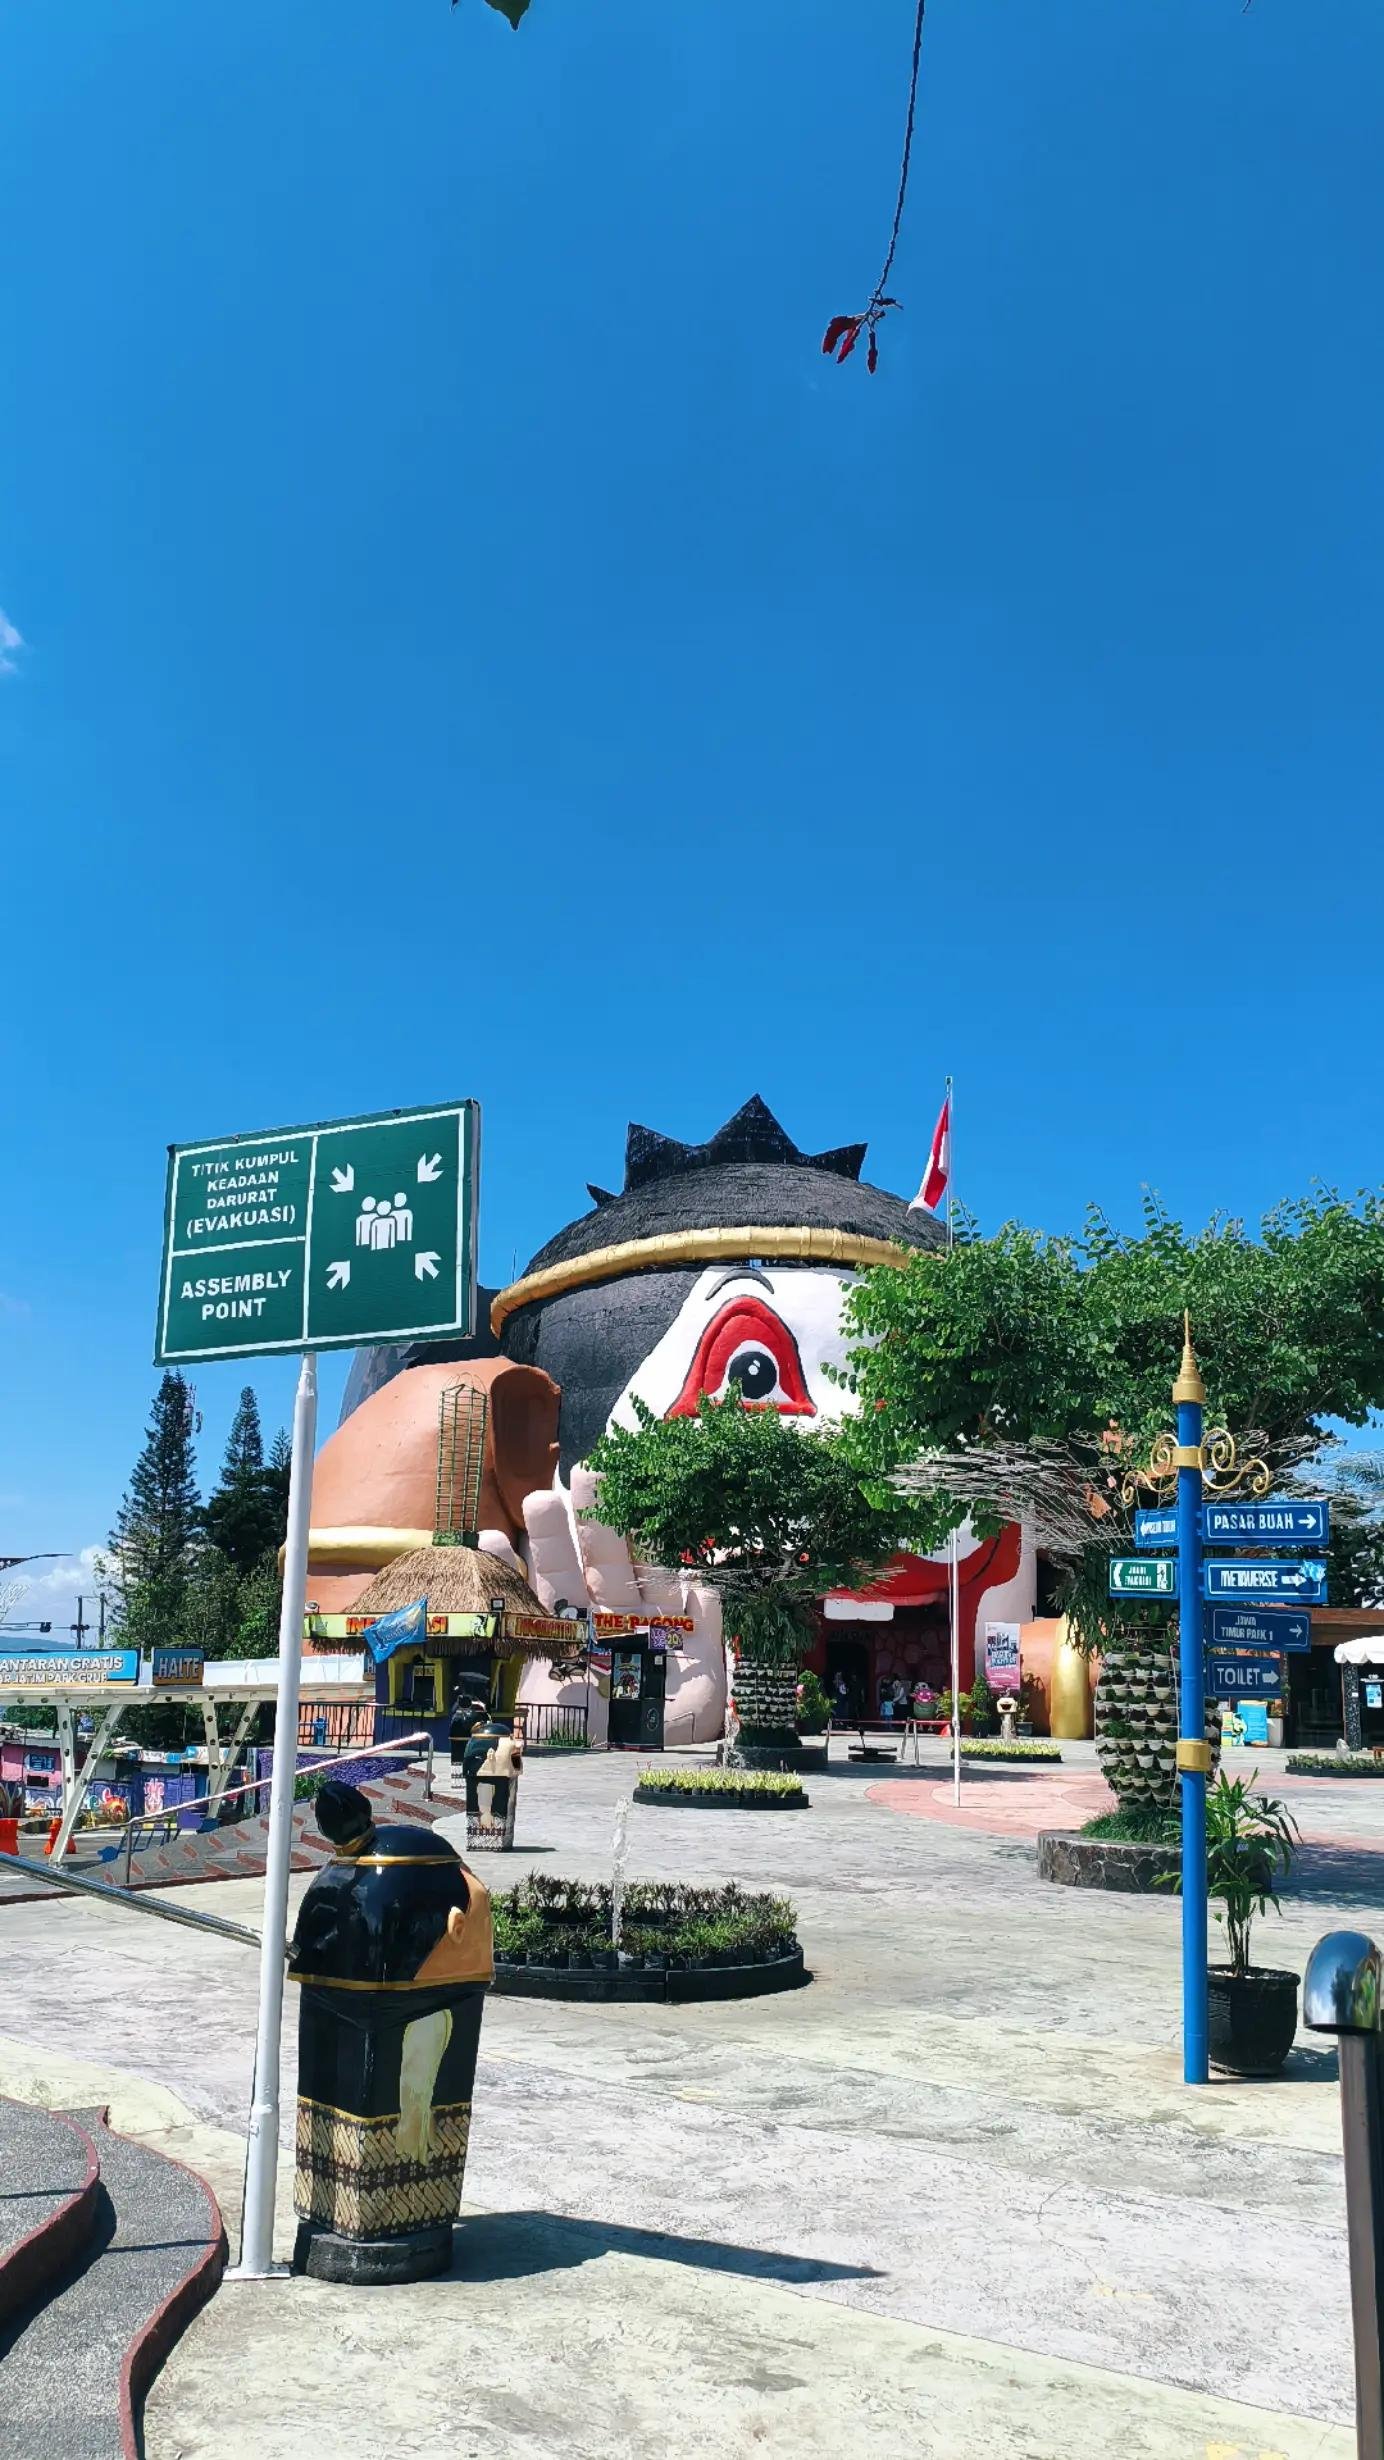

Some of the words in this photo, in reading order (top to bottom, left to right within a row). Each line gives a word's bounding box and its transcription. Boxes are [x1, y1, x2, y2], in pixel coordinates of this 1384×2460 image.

[192, 1161, 229, 1177] TITIK
[235, 1150, 299, 1171] KUMPUL
[207, 1170, 279, 1193] KEADAAN
[207, 1188, 277, 1209] DARURAT
[186, 1204, 296, 1239] (EVAKUASI)
[180, 1269, 292, 1299] ASSEMBLY
[202, 1297, 267, 1321] POINT
[1214, 1514, 1256, 1530] PASAR
[1259, 1512, 1294, 1530] BUAH
[594, 1613, 624, 1629] THE
[70, 1655, 123, 1671] GRATIS
[158, 1656, 199, 1679] HALTE
[1217, 1667, 1260, 1686] TOILET
